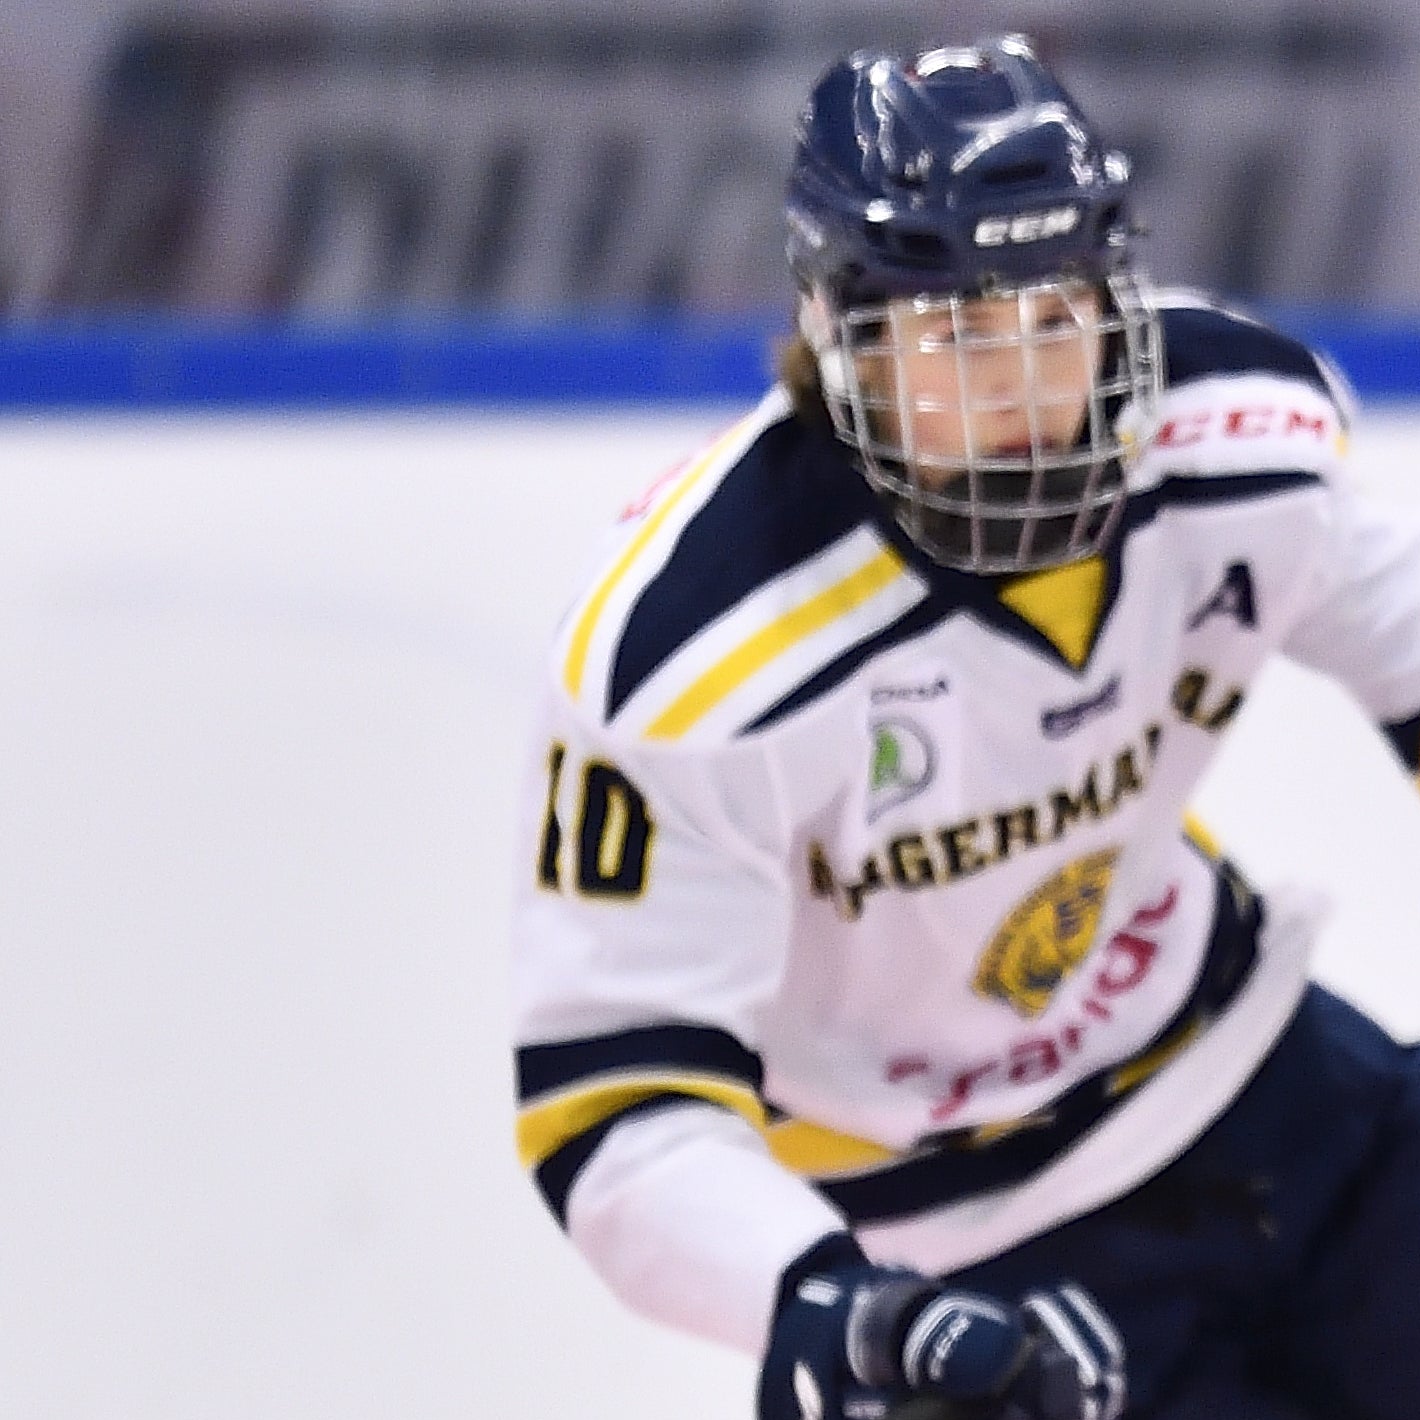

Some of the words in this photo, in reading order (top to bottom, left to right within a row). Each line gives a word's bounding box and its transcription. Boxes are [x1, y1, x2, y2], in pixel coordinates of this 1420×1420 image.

[973, 205, 1081, 247] CCM
[1155, 408, 1329, 450] CCM
[1183, 558, 1257, 632] A
